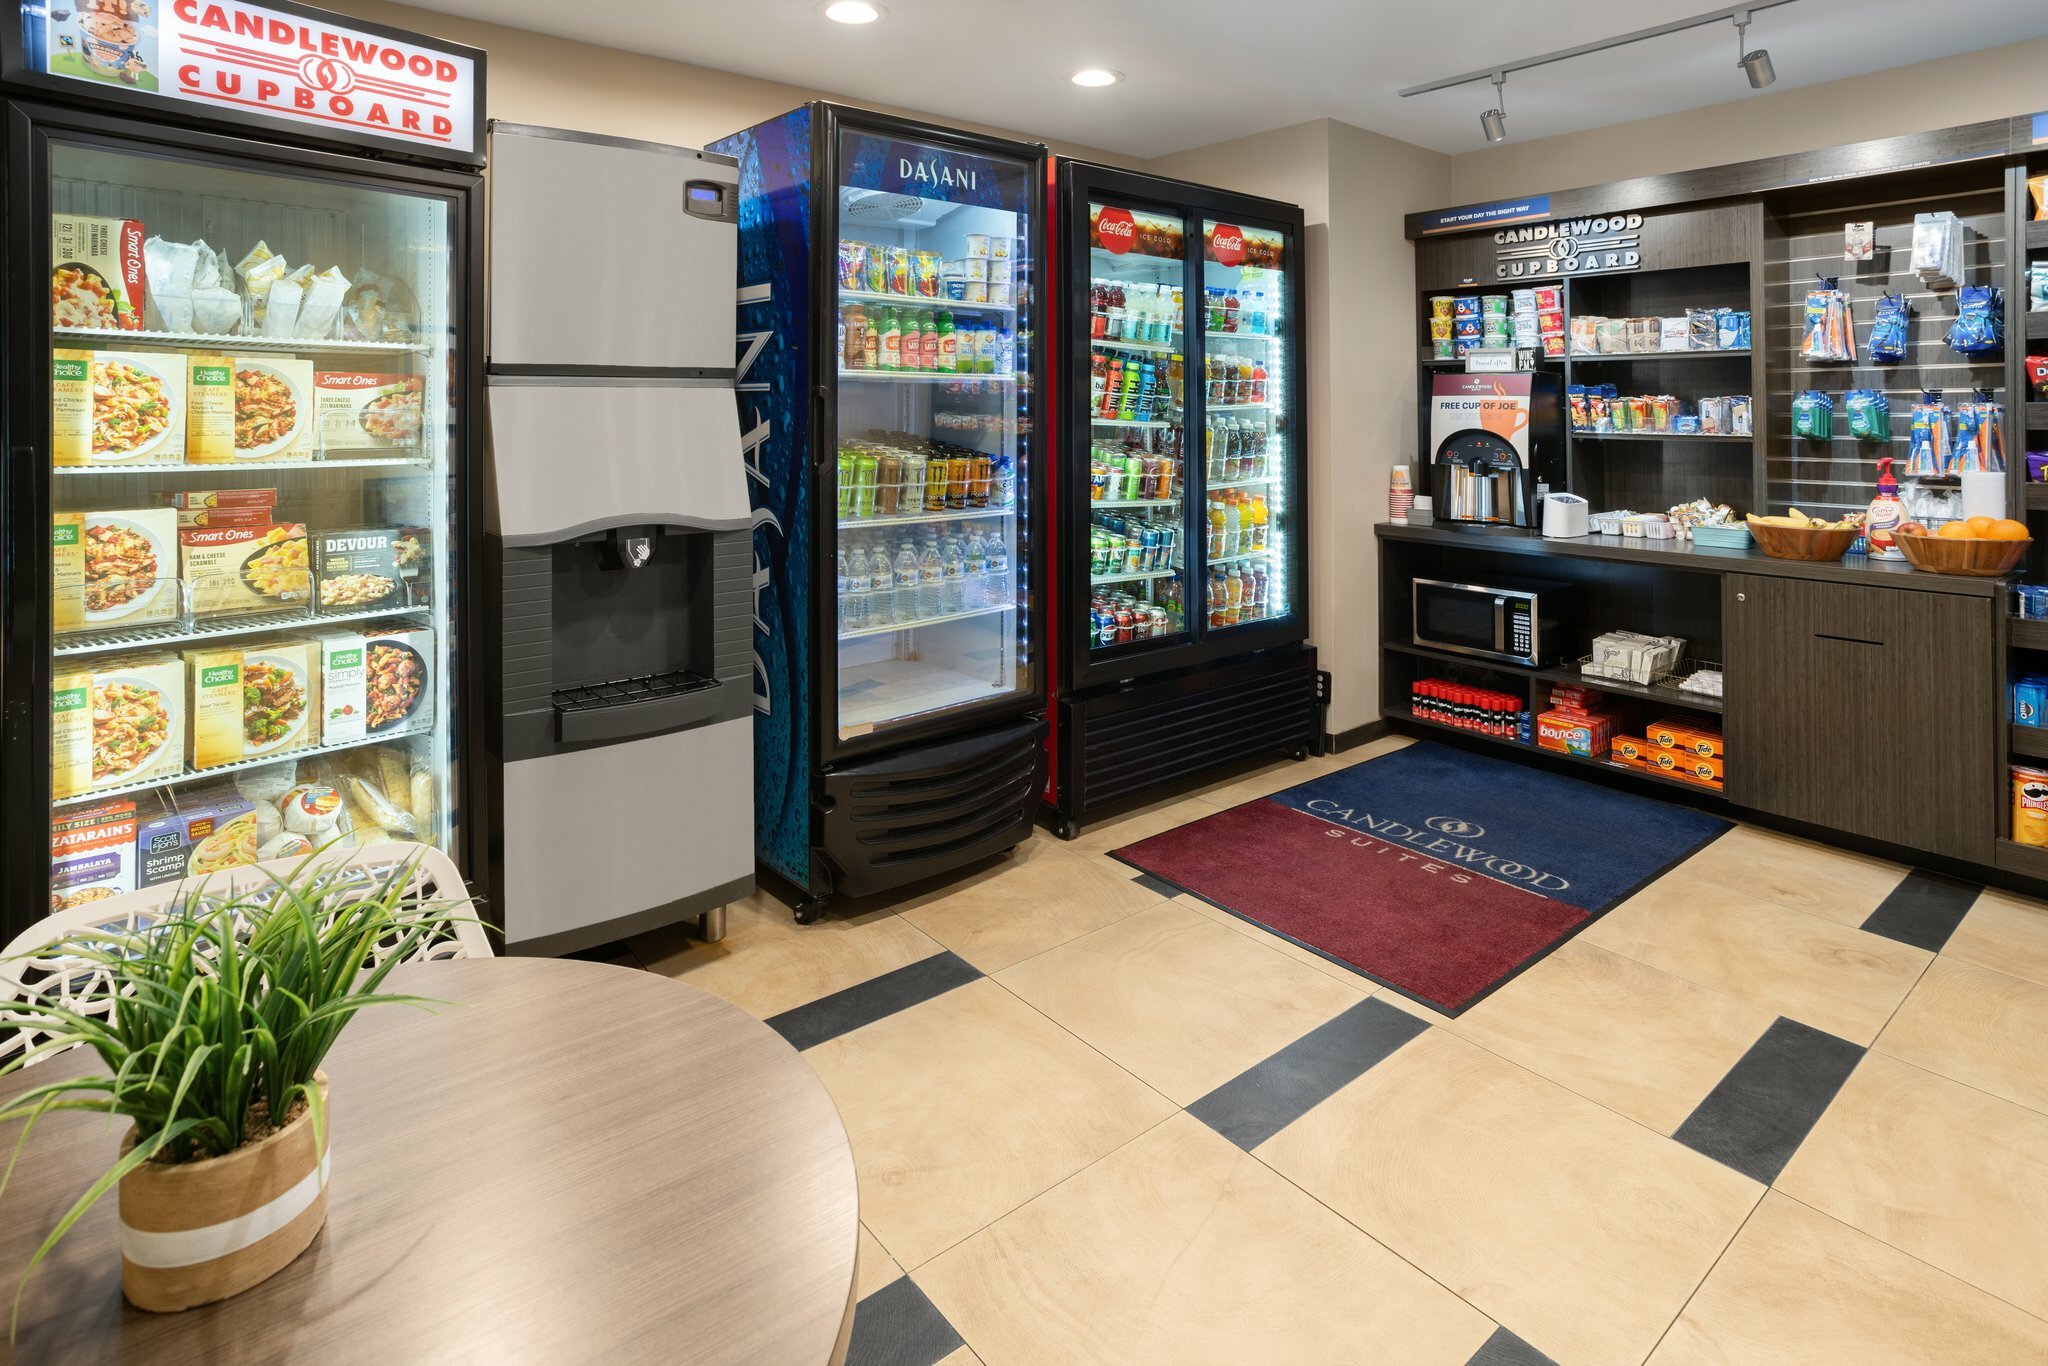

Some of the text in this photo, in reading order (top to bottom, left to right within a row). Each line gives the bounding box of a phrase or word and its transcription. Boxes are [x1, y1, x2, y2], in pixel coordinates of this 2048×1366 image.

[173, 0, 458, 82] CANDLEWOOD
[178, 65, 453, 136] CUPBOARD
[900, 158, 976, 190] DASANI
[1497, 207, 1515, 216] RIGHT
[1099, 218, 1135, 238] Coca-Cola
[1494, 214, 1644, 245] CANDLEWOOD
[1153, 235, 1172, 244] COLD
[1213, 234, 1242, 251] Coca-Cola
[126, 228, 142, 284] Smart Ones
[1496, 251, 1640, 277] CUPBOARD
[1518, 351, 1534, 360] WINE
[322, 375, 378, 386] Smart Ones
[189, 530, 254, 543] Smart Ones
[326, 536, 387, 552] DEVOUR
[205, 674, 234, 684] Choice
[208, 669, 233, 677] Healthy
[328, 668, 365, 681] simply
[54, 698, 81, 708] hoice
[1540, 726, 1582, 740] bounce
[1659, 735, 1673, 744] Tide
[1623, 747, 1636, 755] Tide
[1659, 757, 1673, 766] Tide
[1697, 767, 1712, 776] Tide
[74, 818, 96, 828] SIZE
[52, 824, 134, 848] ZATARAIN'S
[154, 834, 177, 843] Scott
[1306, 799, 1570, 891] CANDLEWOOD
[146, 854, 184, 868] Shrimp
[1325, 829, 1472, 884] SUITES
[58, 858, 112, 874] JAMBALAYA
[146, 860, 185, 875] Scampi
